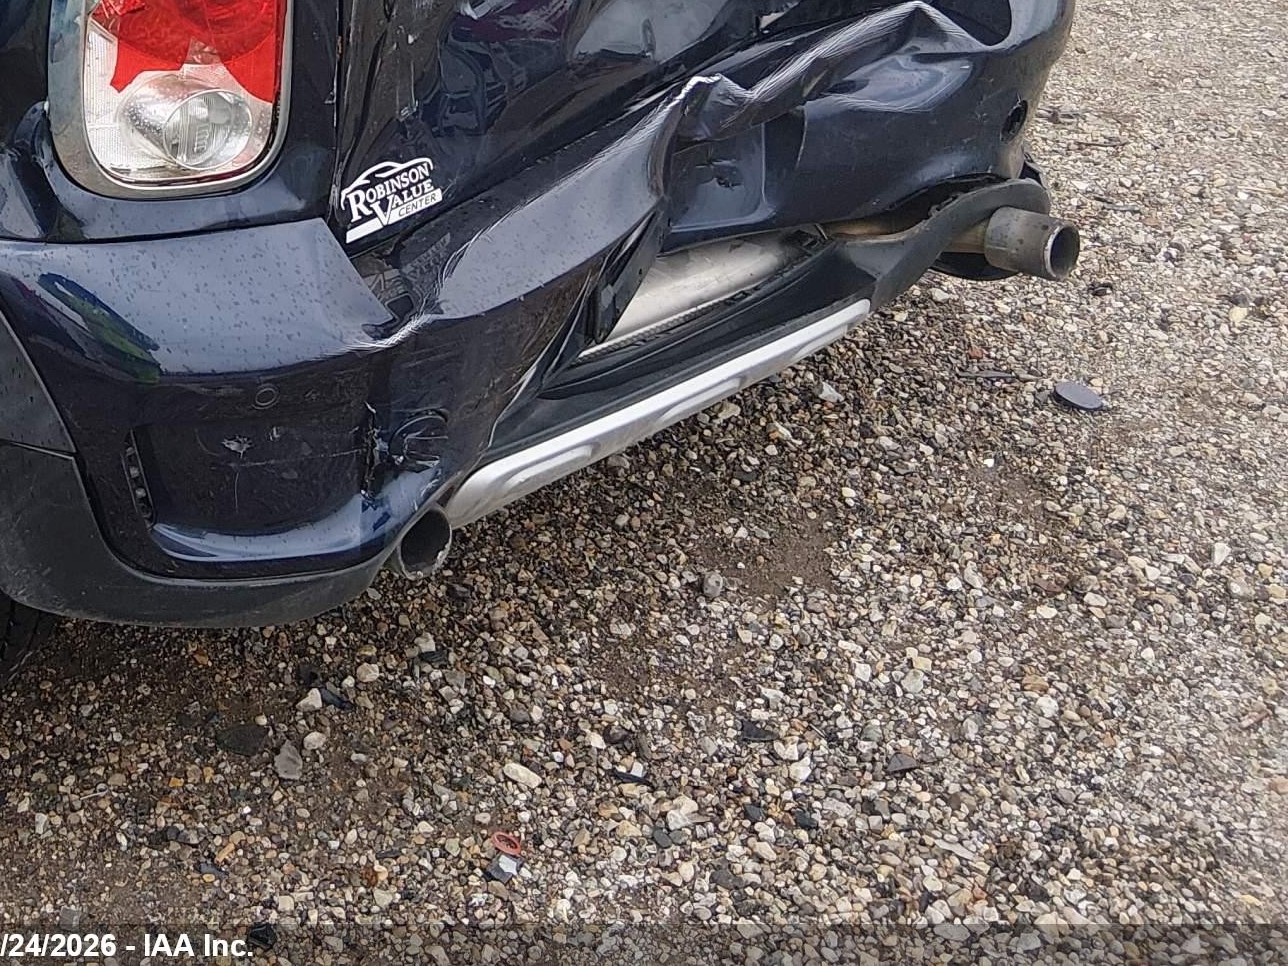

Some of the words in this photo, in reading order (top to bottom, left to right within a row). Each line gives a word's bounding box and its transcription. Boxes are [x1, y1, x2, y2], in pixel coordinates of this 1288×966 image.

[346, 162, 430, 223] ROBINSON
[369, 178, 435, 227] VALUE
[398, 192, 437, 217] CENTER
